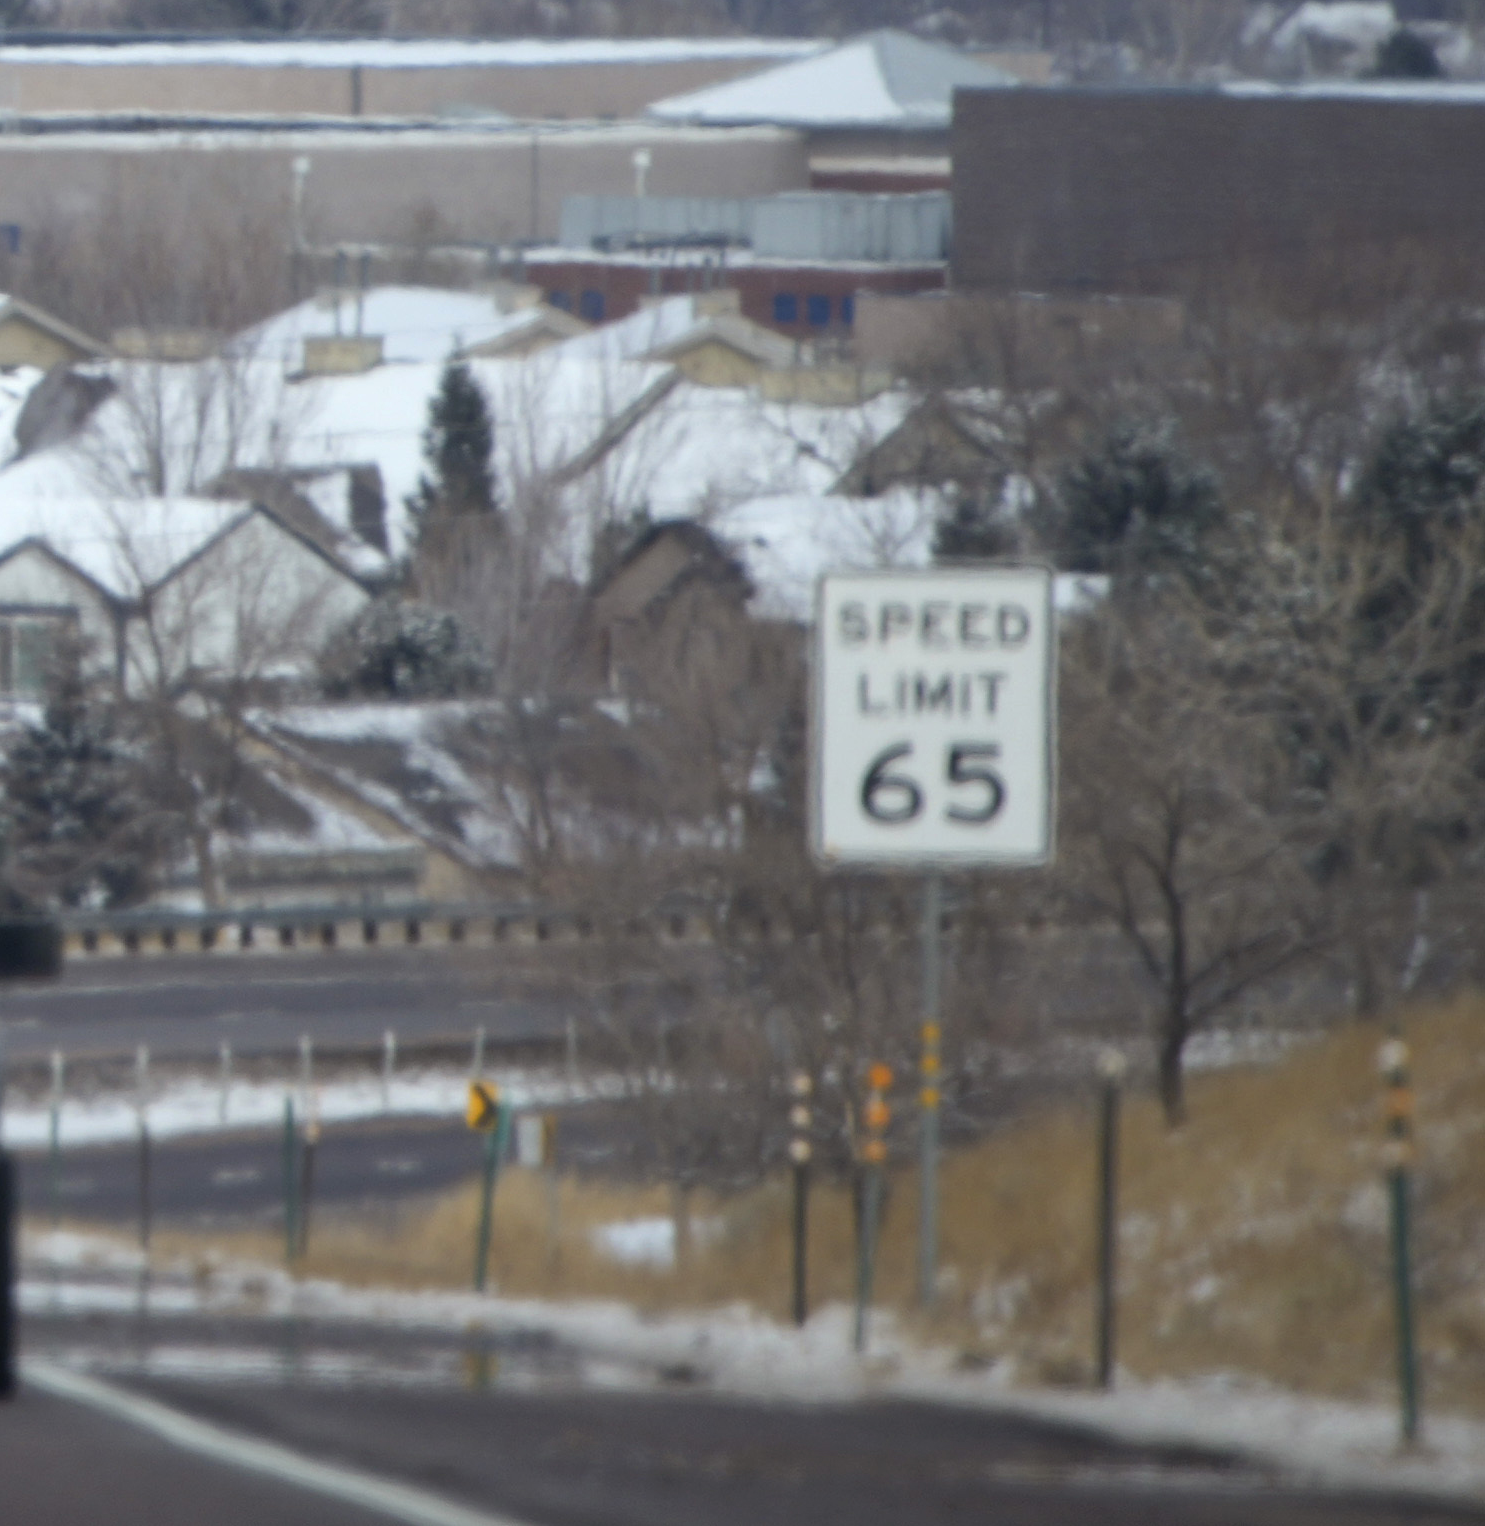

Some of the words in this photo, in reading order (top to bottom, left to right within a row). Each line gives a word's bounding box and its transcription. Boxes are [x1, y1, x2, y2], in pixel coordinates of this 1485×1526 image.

[838, 601, 1029, 647] SPEED
[858, 673, 1005, 716] LIMIT
[860, 740, 1007, 825] 65
